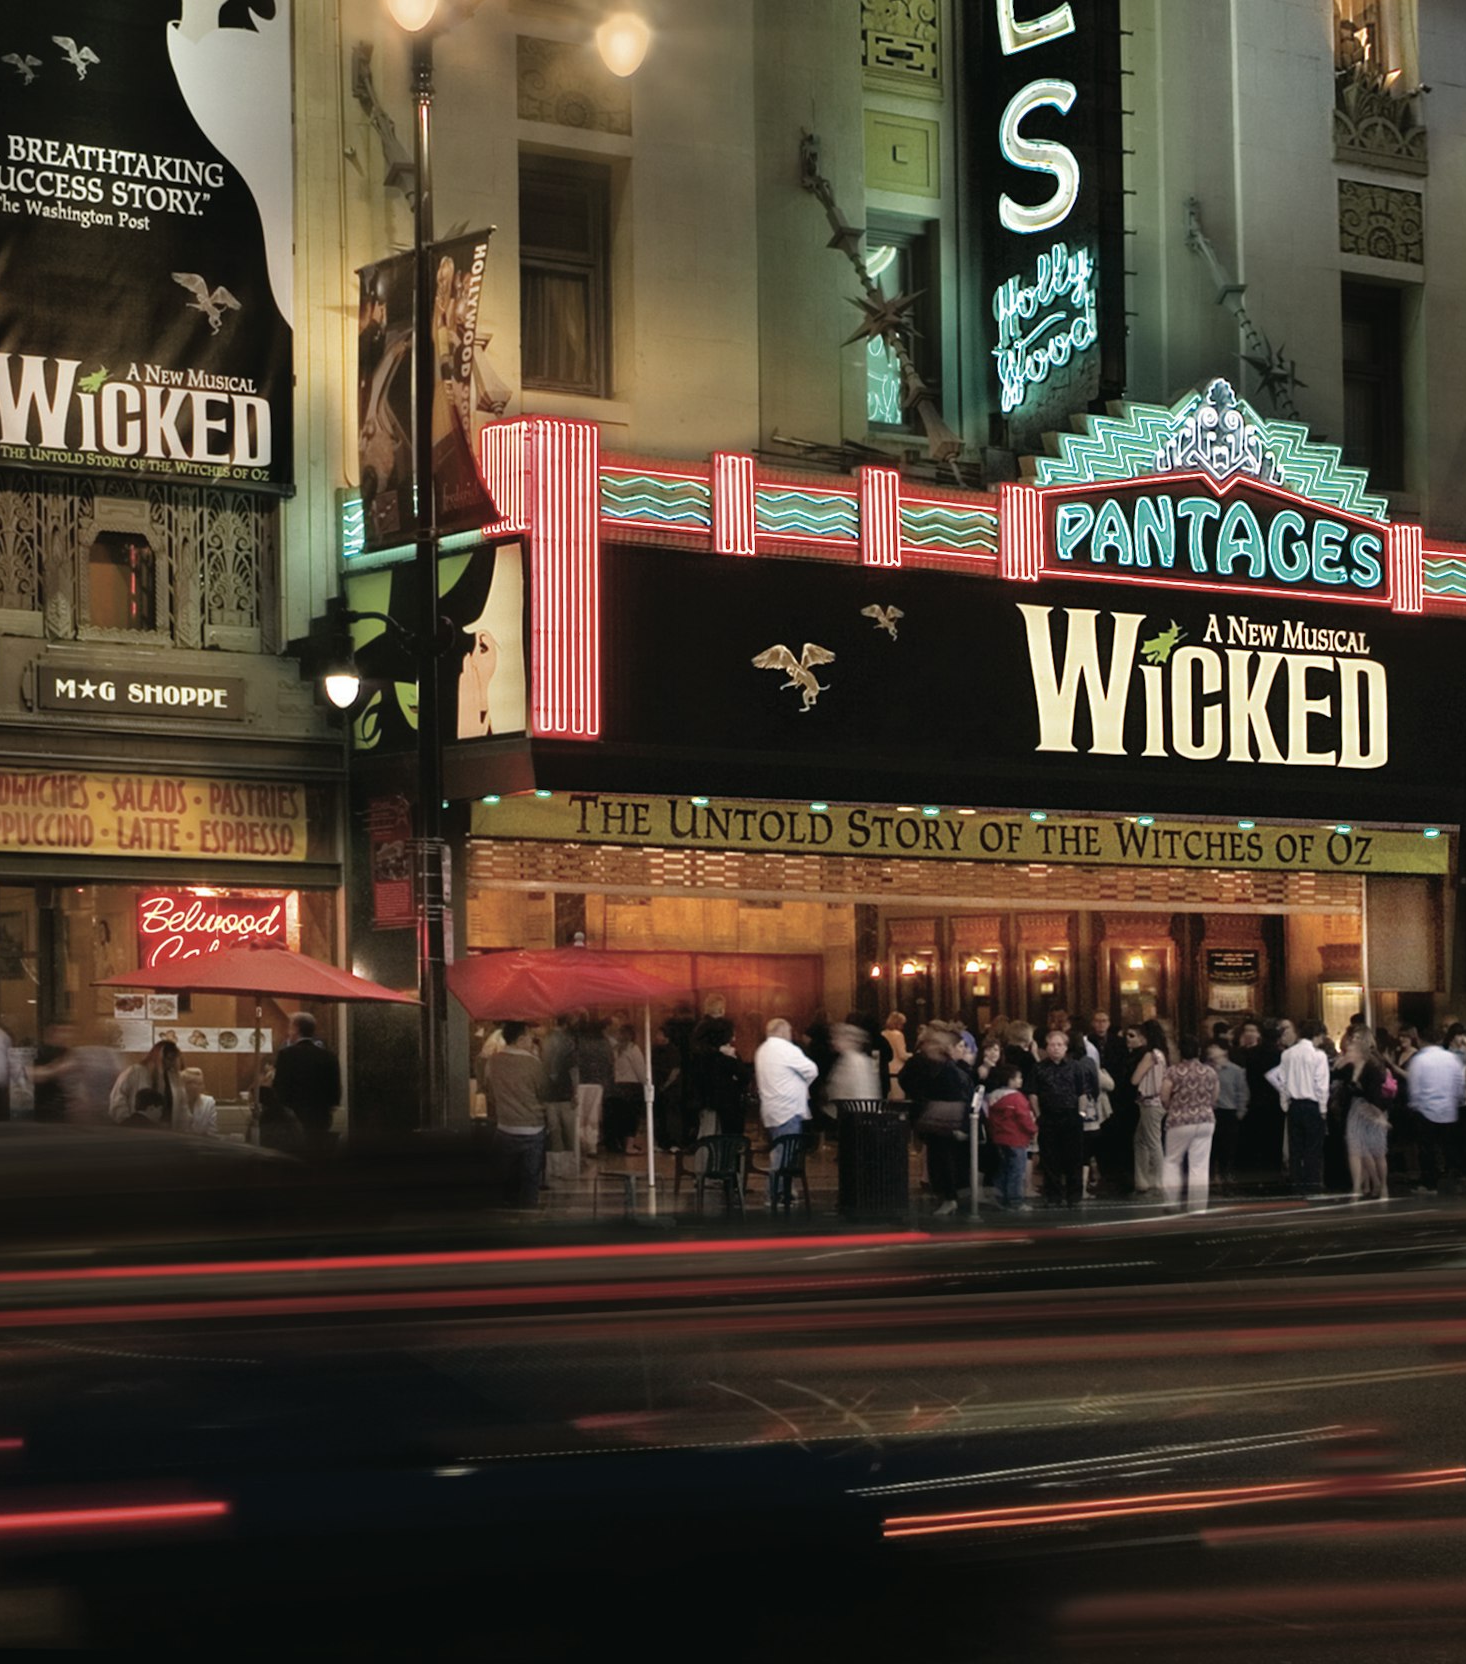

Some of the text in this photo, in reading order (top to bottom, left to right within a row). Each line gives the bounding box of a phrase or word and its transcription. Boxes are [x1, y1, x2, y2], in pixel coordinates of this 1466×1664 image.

[7, 134, 225, 188] BREATHTAKING
[25, 199, 114, 229] Washington
[118, 211, 150, 231] Post
[460, 242, 488, 378] HOLLYWOOD
[993, 242, 1095, 349] Holly
[126, 362, 142, 382] A
[991, 289, 1098, 413] Wood
[1054, 493, 1383, 589] PANTAGES
[1202, 613, 1224, 644] A
[127, 682, 228, 709] SHOPPE
[111, 776, 188, 815] SALADS
[209, 782, 300, 820] PASTRIES
[116, 816, 182, 852] LATTE
[199, 819, 295, 856] ESPRESSO
[140, 896, 281, 936] Belwood
